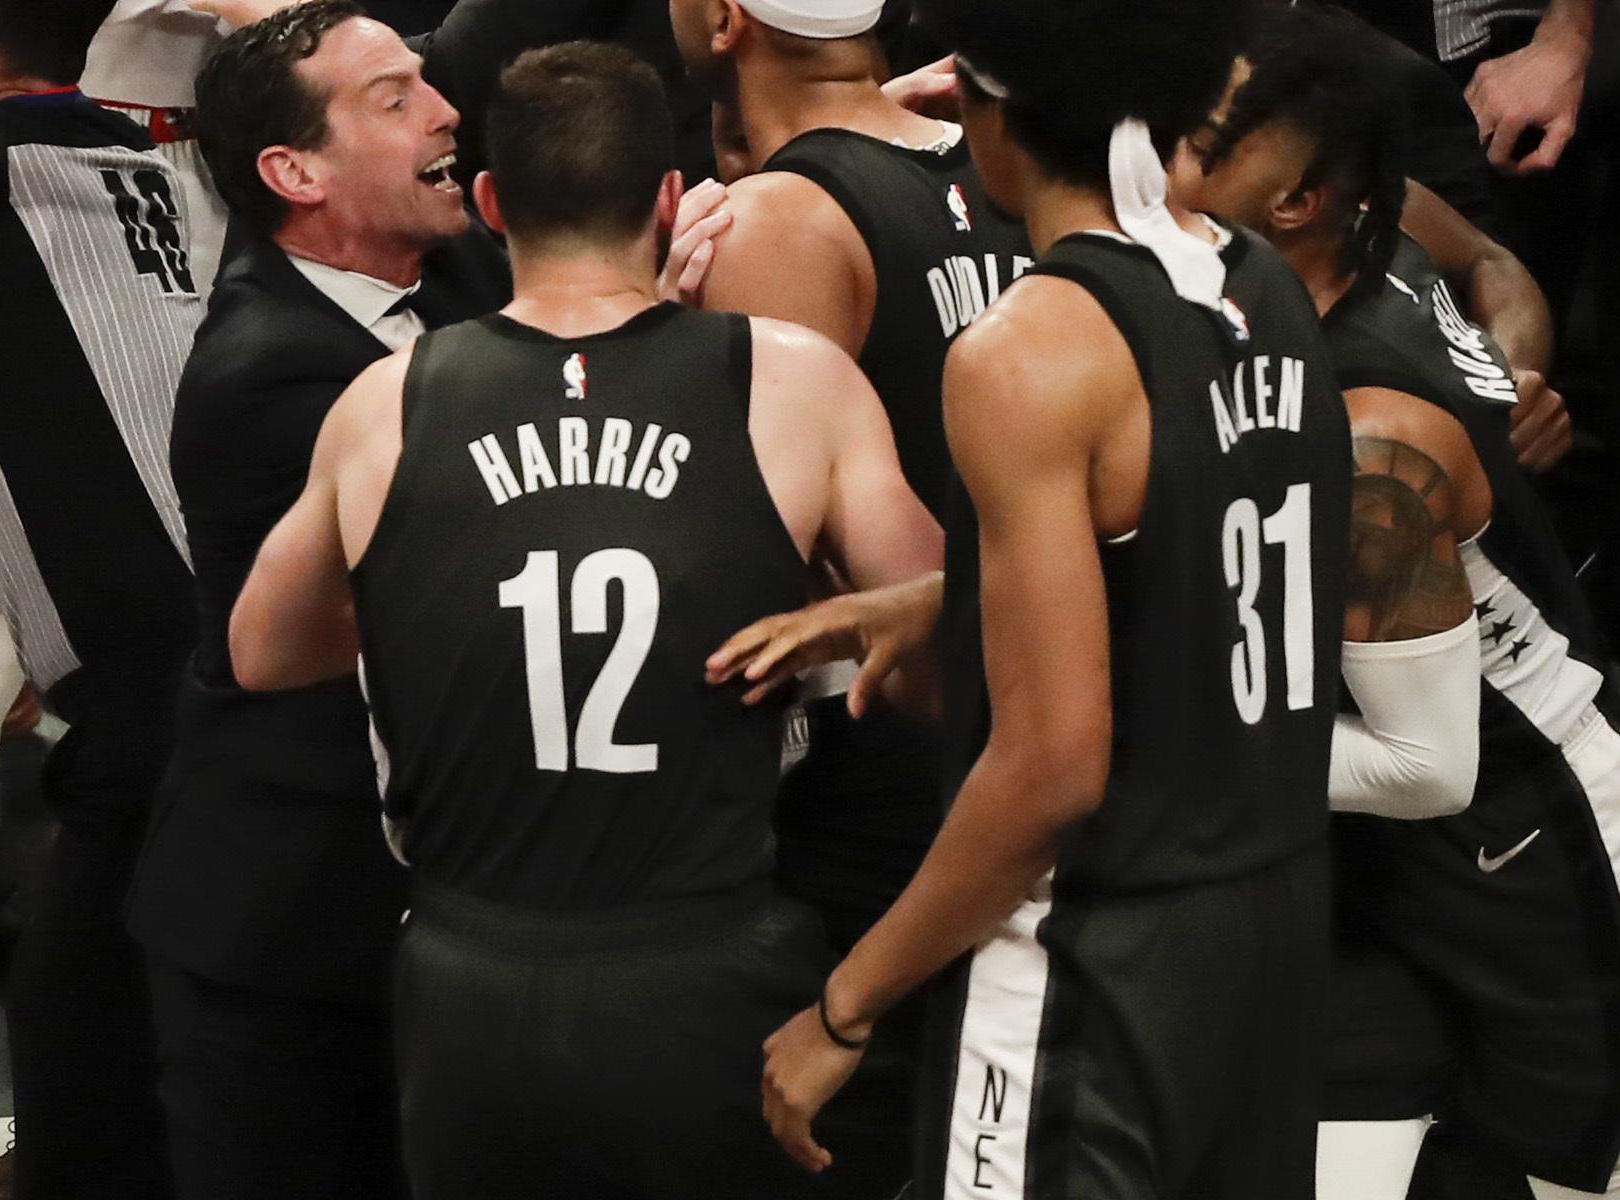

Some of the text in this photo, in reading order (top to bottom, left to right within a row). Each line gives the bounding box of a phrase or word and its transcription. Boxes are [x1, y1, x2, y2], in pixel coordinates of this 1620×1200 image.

[467, 416, 692, 507] HARRIS
[1209, 354, 1305, 454] ALEN
[497, 546, 661, 774] 12
[1221, 481, 1315, 726] 31
